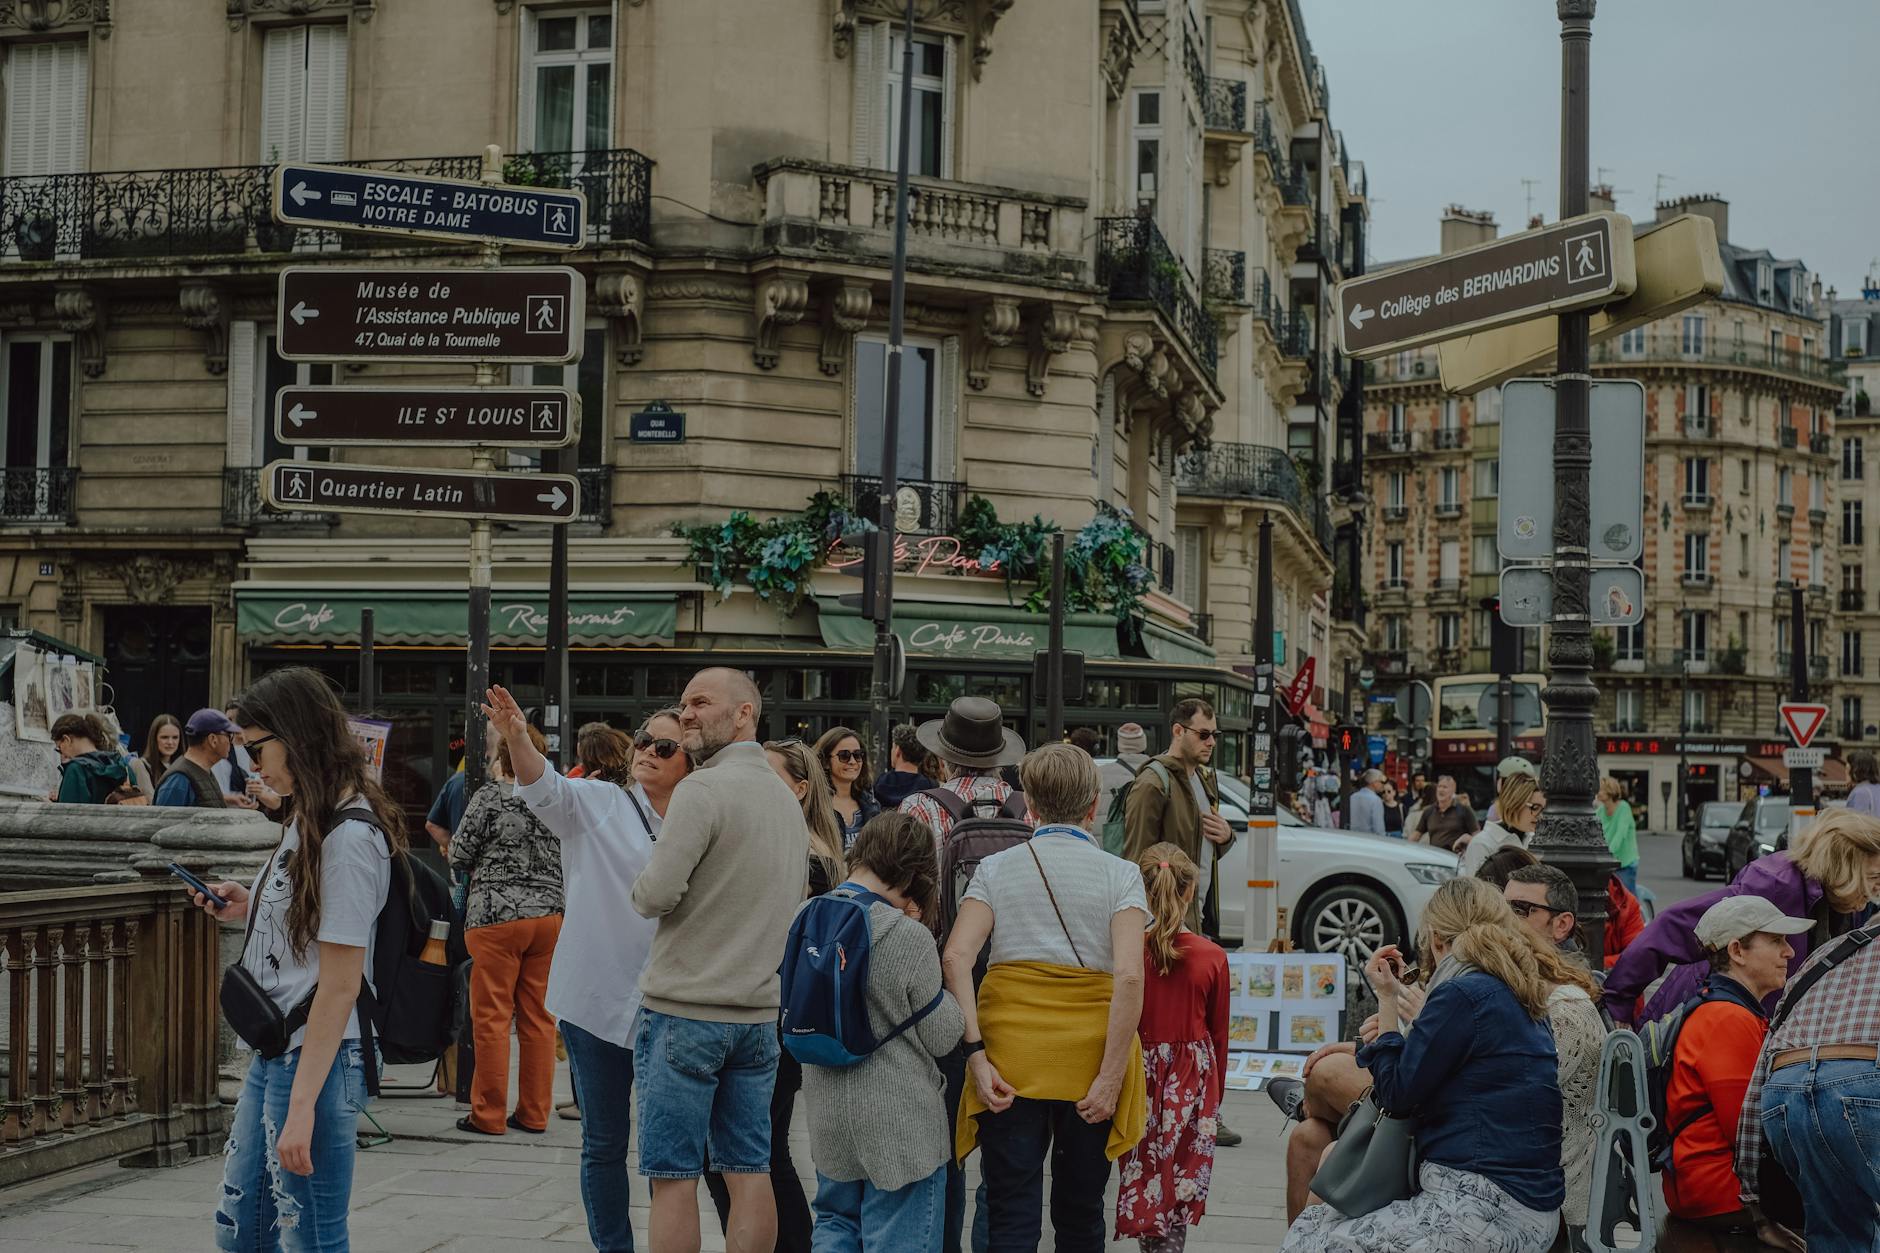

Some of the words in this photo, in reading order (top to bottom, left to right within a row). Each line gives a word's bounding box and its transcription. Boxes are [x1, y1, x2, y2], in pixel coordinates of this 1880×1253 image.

[362, 182, 434, 207] ESCALE
[452, 191, 539, 216] BATOBUS
[362, 204, 417, 225] NOTRE
[423, 211, 471, 229] DAME
[356, 281, 419, 299] Musée
[428, 281, 451, 300] de
[1379, 292, 1432, 320] Collège
[1434, 284, 1460, 304] des
[1462, 255, 1561, 300] BERNARDINS
[452, 306, 521, 329] Publique
[377, 332, 406, 348] Quai
[409, 332, 426, 347] de
[428, 332, 441, 347] la
[445, 332, 501, 348] Tournelle
[398, 408, 426, 425] ILE
[467, 408, 526, 426] LOUIS
[650, 419, 665, 428] QUAI
[637, 430, 677, 438] MONTEBELLO
[319, 478, 404, 501] Quartier
[413, 483, 464, 504] Latin
[500, 604, 635, 633] Resurant
[910, 623, 967, 650] Café
